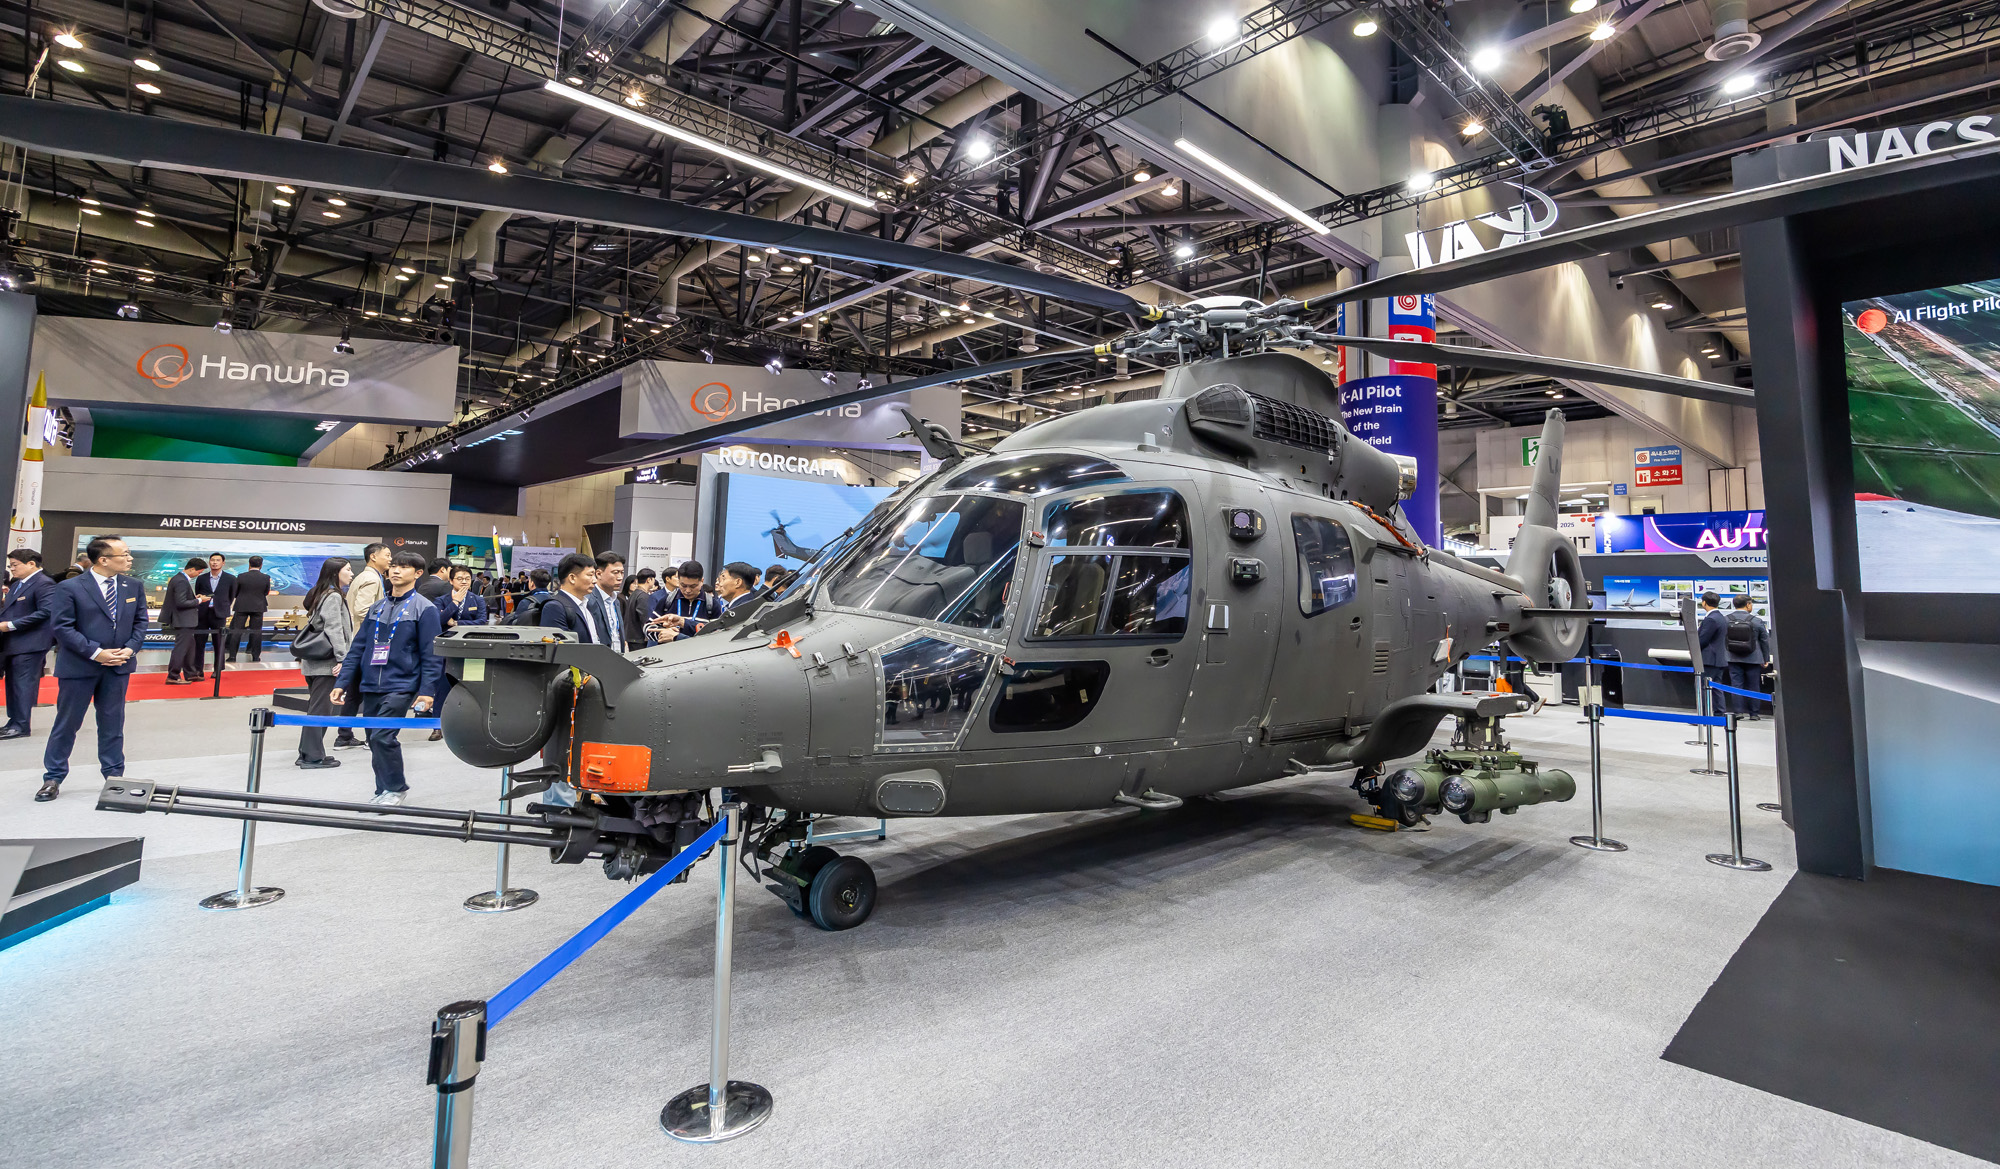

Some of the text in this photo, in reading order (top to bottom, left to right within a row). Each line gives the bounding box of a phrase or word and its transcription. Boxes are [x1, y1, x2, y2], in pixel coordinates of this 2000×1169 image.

[1894, 309, 1911, 324] AI
[1916, 302, 1969, 321] Flight
[200, 354, 350, 387] Hanwha
[1341, 385, 1402, 405] K-AI Pilot
[1341, 404, 1402, 419] The New Brain
[1353, 421, 1380, 432] of the
[718, 446, 840, 478] ROTORCRAFT
[160, 517, 306, 532] AIR DEFENSE SOLUTIONS
